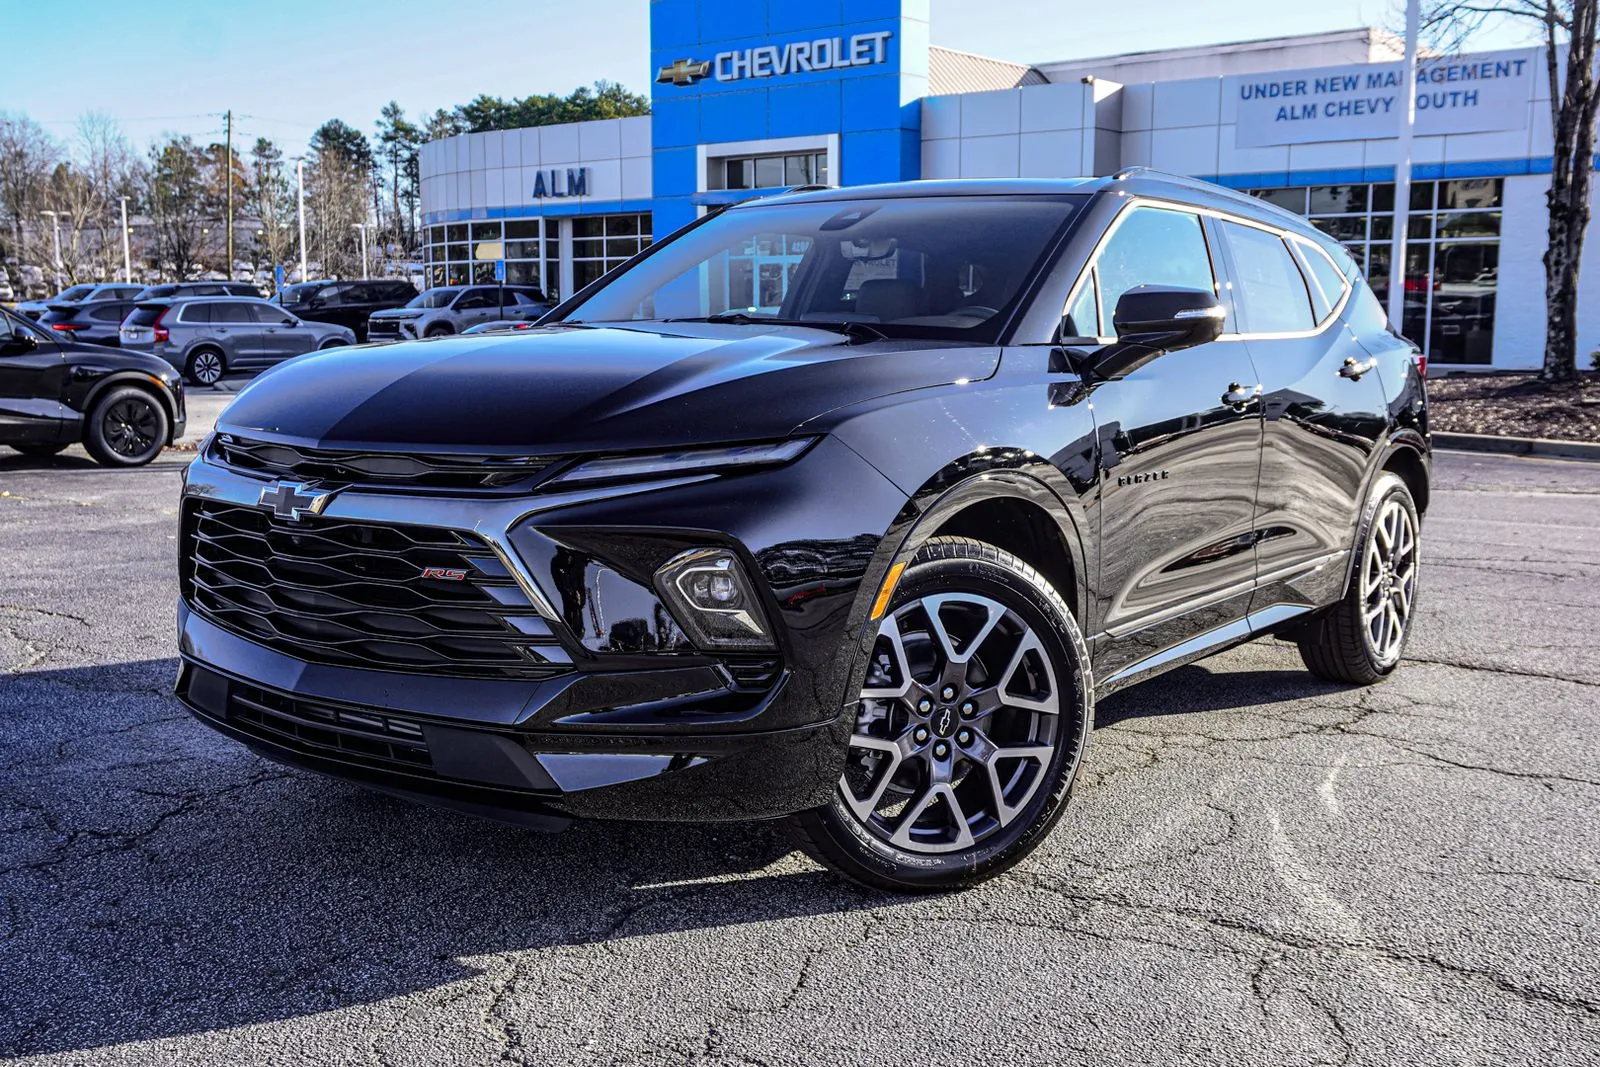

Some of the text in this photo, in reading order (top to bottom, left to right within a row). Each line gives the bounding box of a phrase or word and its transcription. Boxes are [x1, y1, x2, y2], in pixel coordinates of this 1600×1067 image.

[714, 30, 893, 82] CHEVROLET
[1241, 81, 1306, 100] UNDER
[1315, 74, 1360, 94] NEW
[1275, 90, 1479, 122] ALM CHEVY OUTH
[532, 167, 588, 199] ALM
[1118, 470, 1169, 486] BLAZER
[421, 567, 467, 581] RS
